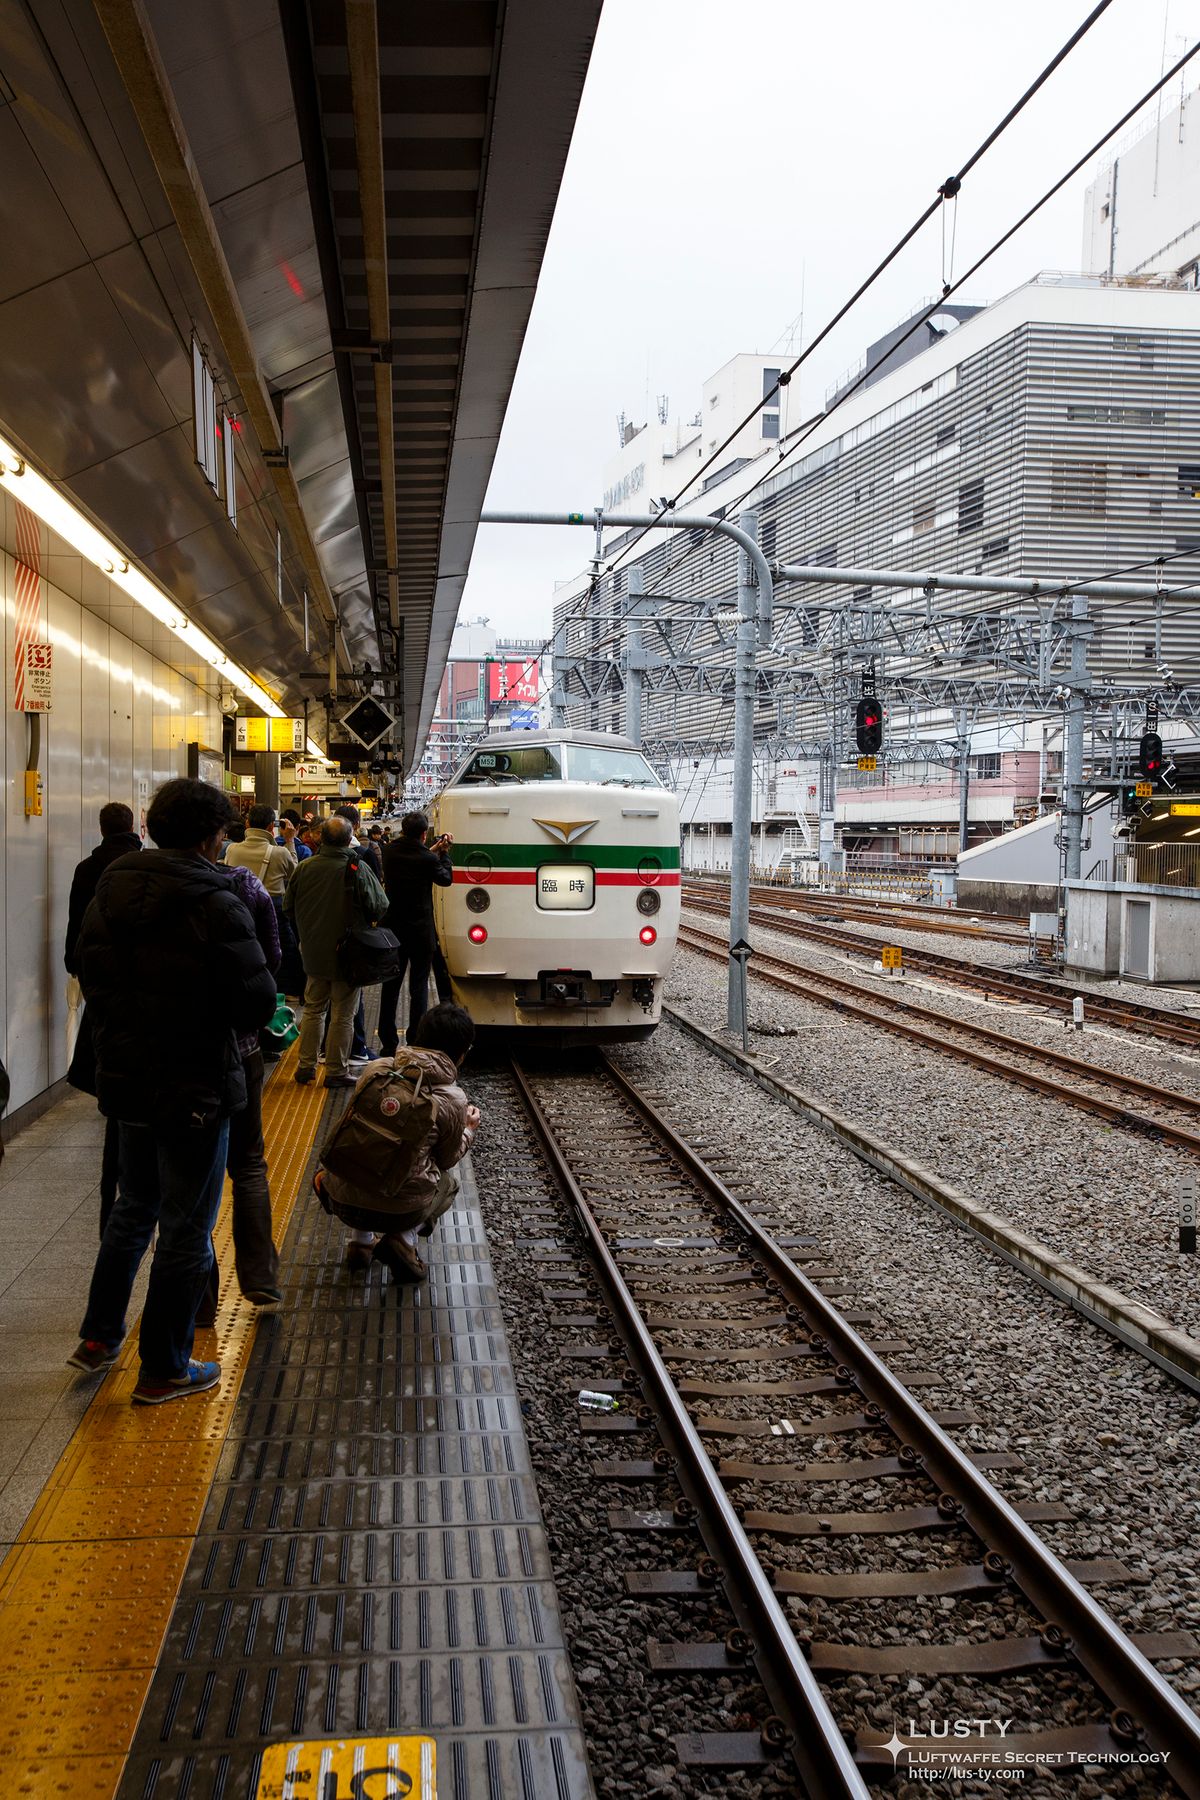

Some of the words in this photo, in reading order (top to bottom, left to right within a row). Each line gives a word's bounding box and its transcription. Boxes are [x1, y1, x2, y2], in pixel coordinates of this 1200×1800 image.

[517, 681, 537, 698] アイフル
[480, 758, 495, 766] M52
[541, 879, 585, 893] 臨時
